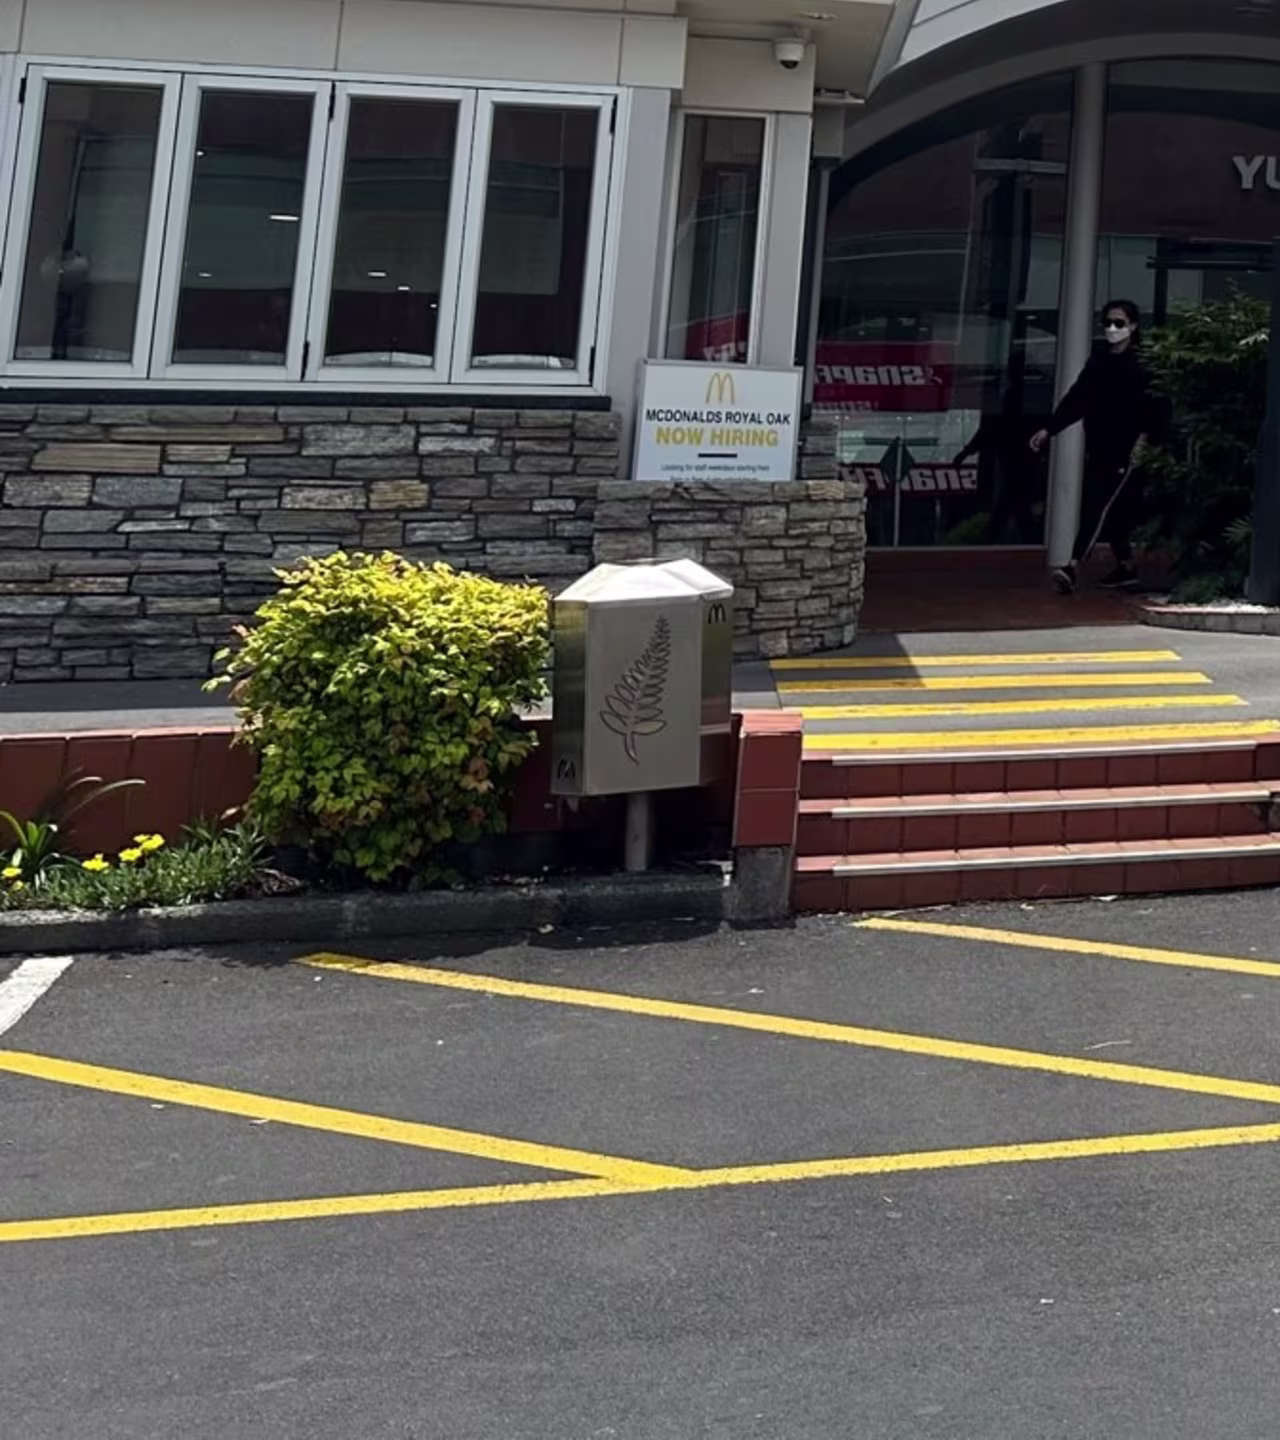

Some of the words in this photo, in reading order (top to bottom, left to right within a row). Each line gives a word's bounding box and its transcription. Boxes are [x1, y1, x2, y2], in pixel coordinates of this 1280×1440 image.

[645, 409, 722, 424] MCDONALDS
[725, 412, 763, 424] ROYAL
[766, 412, 791, 426] OAK
[656, 426, 704, 445] NOW
[709, 428, 779, 448] HIRING
